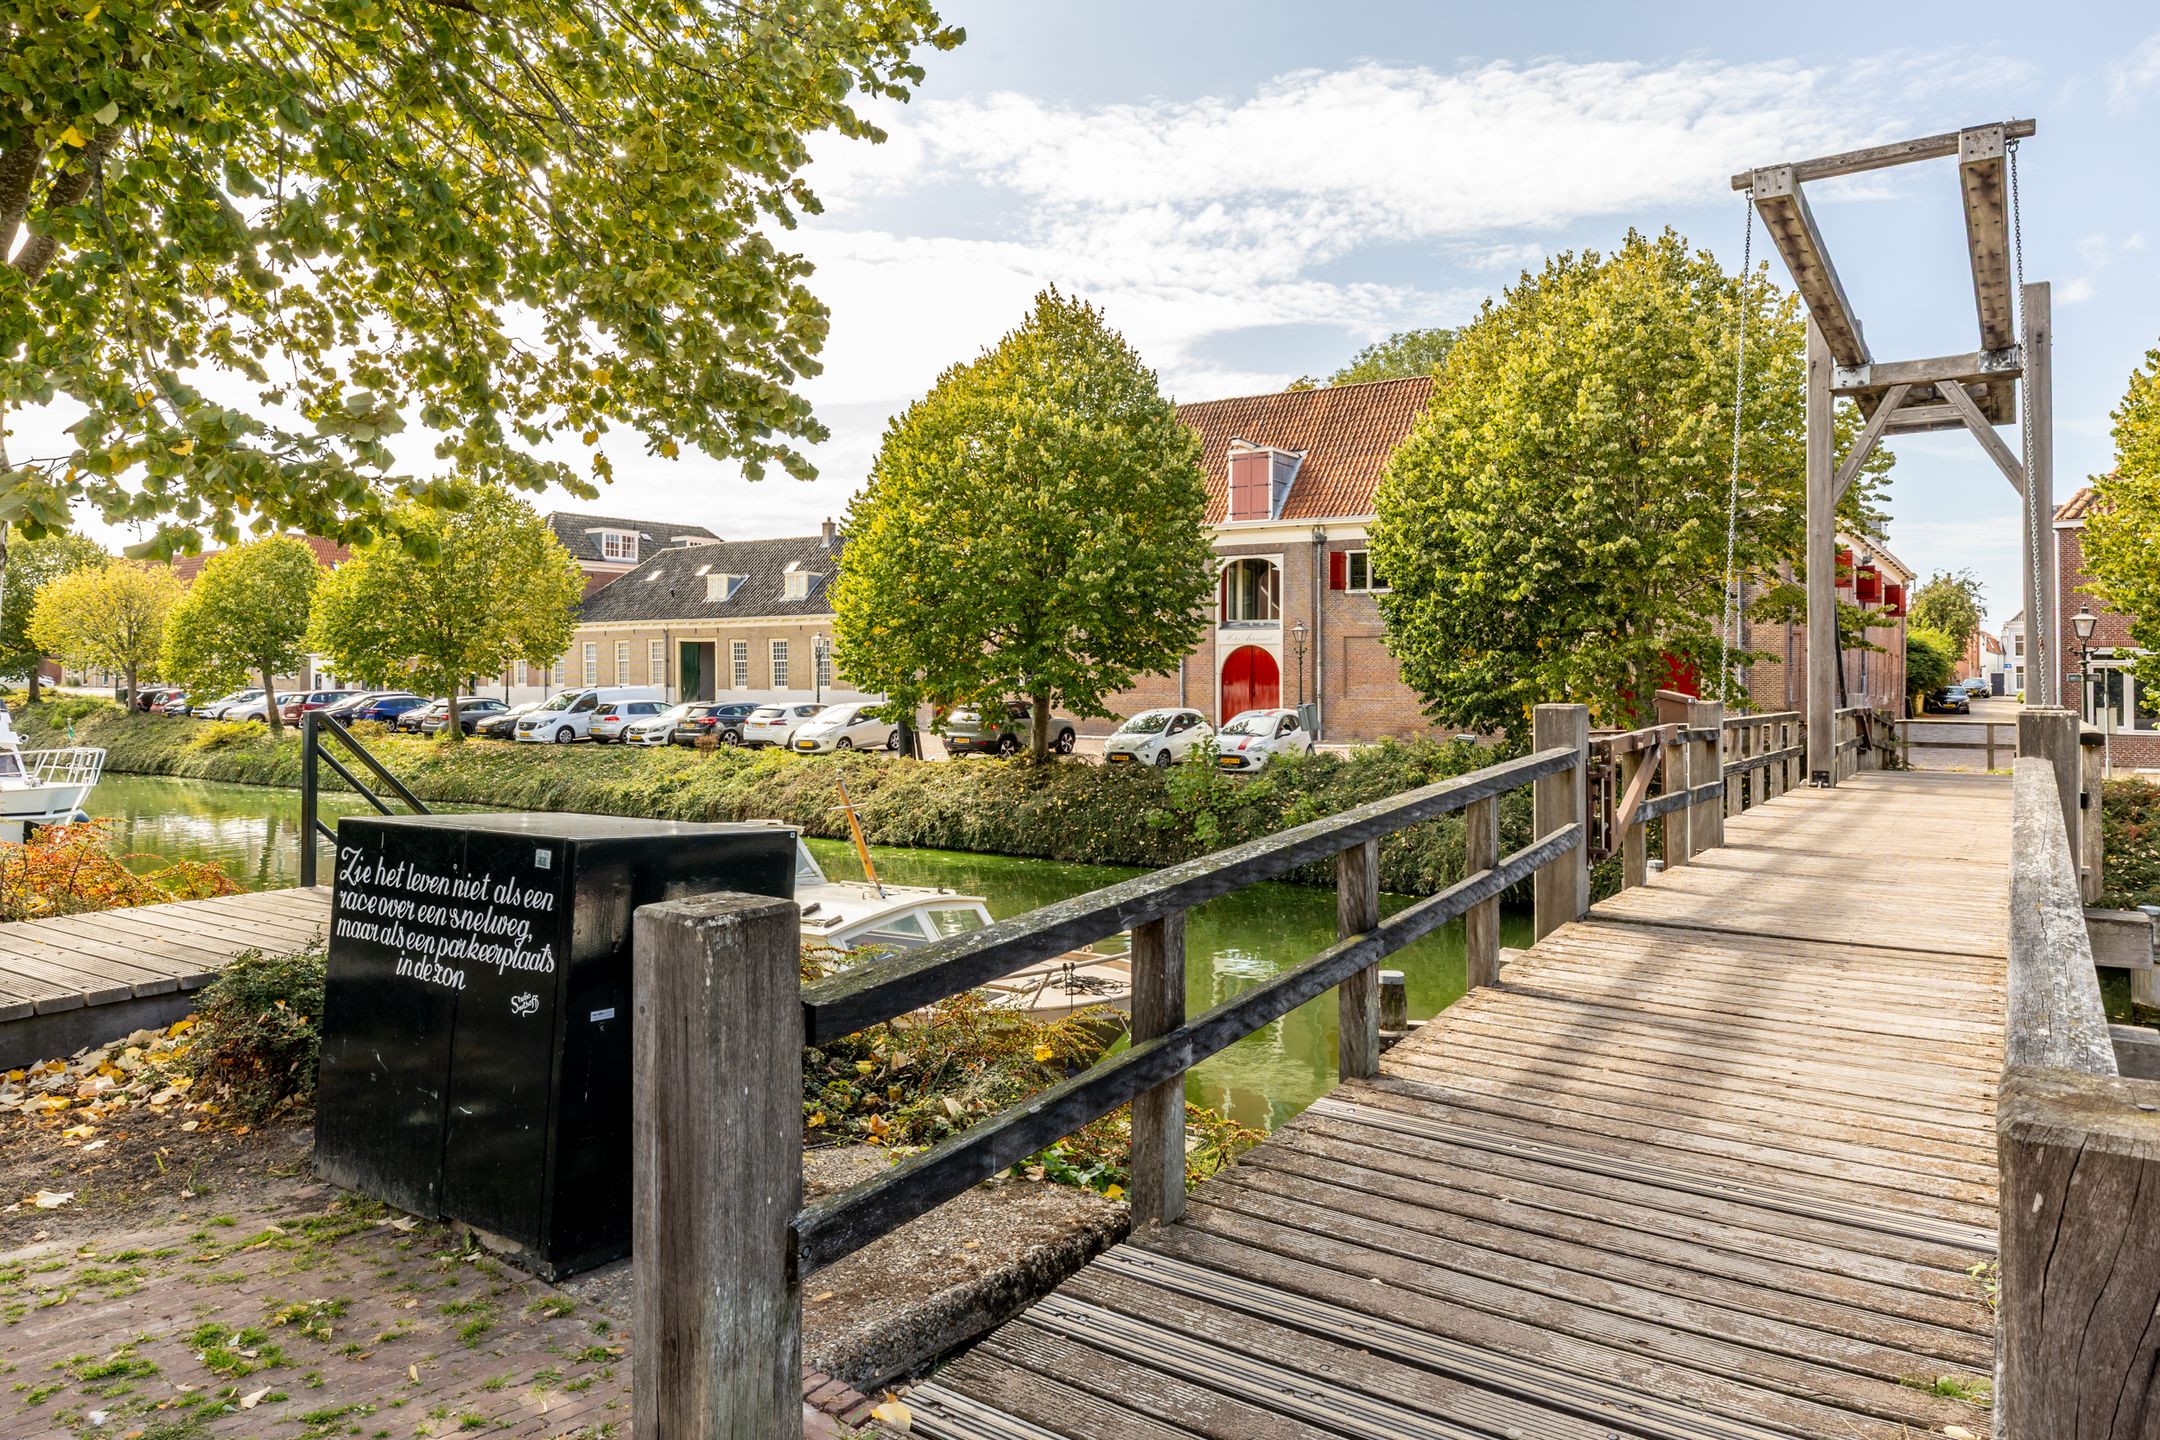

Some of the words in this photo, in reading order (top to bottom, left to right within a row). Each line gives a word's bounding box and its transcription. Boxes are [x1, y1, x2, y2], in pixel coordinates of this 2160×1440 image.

[340, 846, 372, 886] Zie
[374, 855, 402, 888] het
[406, 862, 450, 895] leven
[452, 872, 491, 900] niet
[494, 876, 521, 906] als
[524, 889, 554, 912] een
[336, 917, 379, 942] maar
[380, 920, 404, 948] als
[406, 931, 436, 954] een
[434, 933, 555, 976] parkeerplaats
[340, 890, 378, 914] race
[378, 897, 415, 920] over
[418, 905, 447, 926] een
[449, 905, 533, 948] snelweg,
[396, 949, 413, 976] in
[414, 955, 433, 982] de
[432, 963, 466, 990] zon
